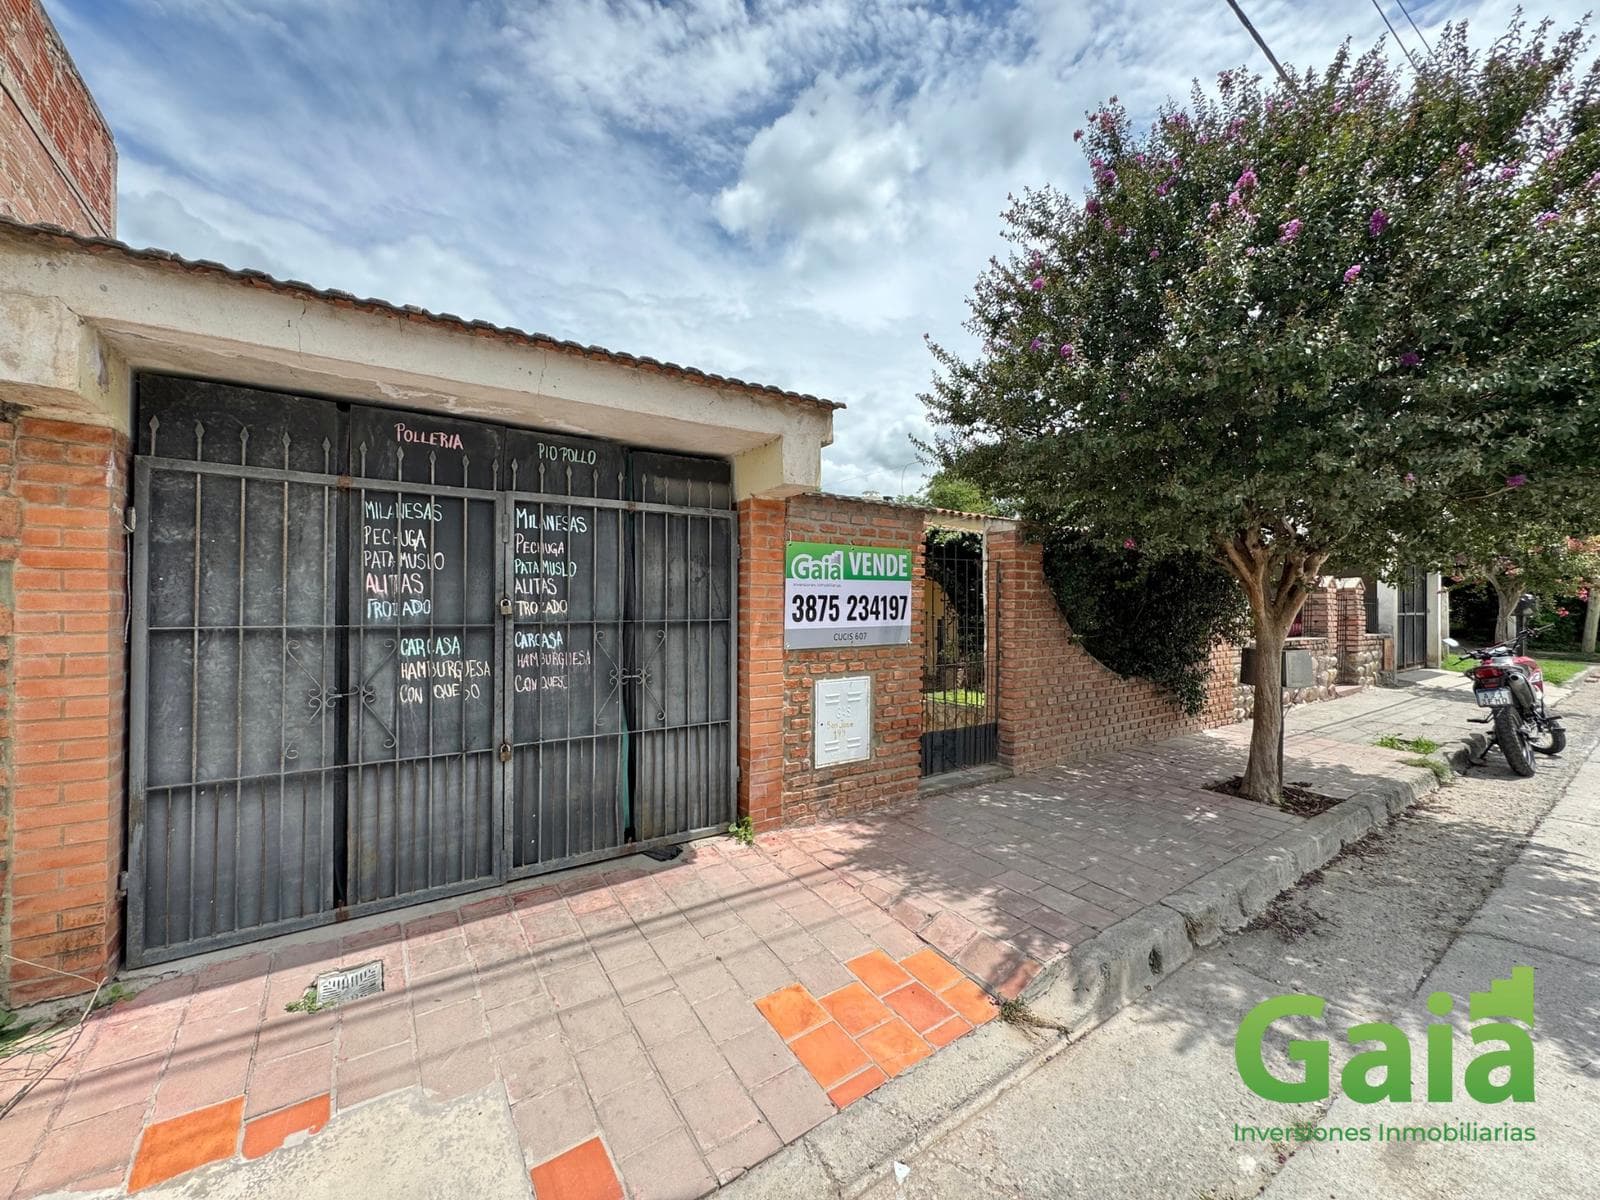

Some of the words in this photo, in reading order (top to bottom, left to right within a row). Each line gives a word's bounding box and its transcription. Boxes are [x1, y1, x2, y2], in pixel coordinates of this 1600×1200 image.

[394, 422, 464, 450] POLLERIA
[537, 442, 558, 461] PIO
[559, 447, 597, 465] POLLO
[791, 551, 843, 580] Gaia
[848, 551, 908, 577] VENDE
[515, 577, 558, 595] ALITAS
[792, 594, 840, 623] 3875
[846, 594, 908, 621] 234197
[514, 630, 564, 650] CARCASA
[854, 631, 868, 640] 607
[400, 683, 423, 704] CON
